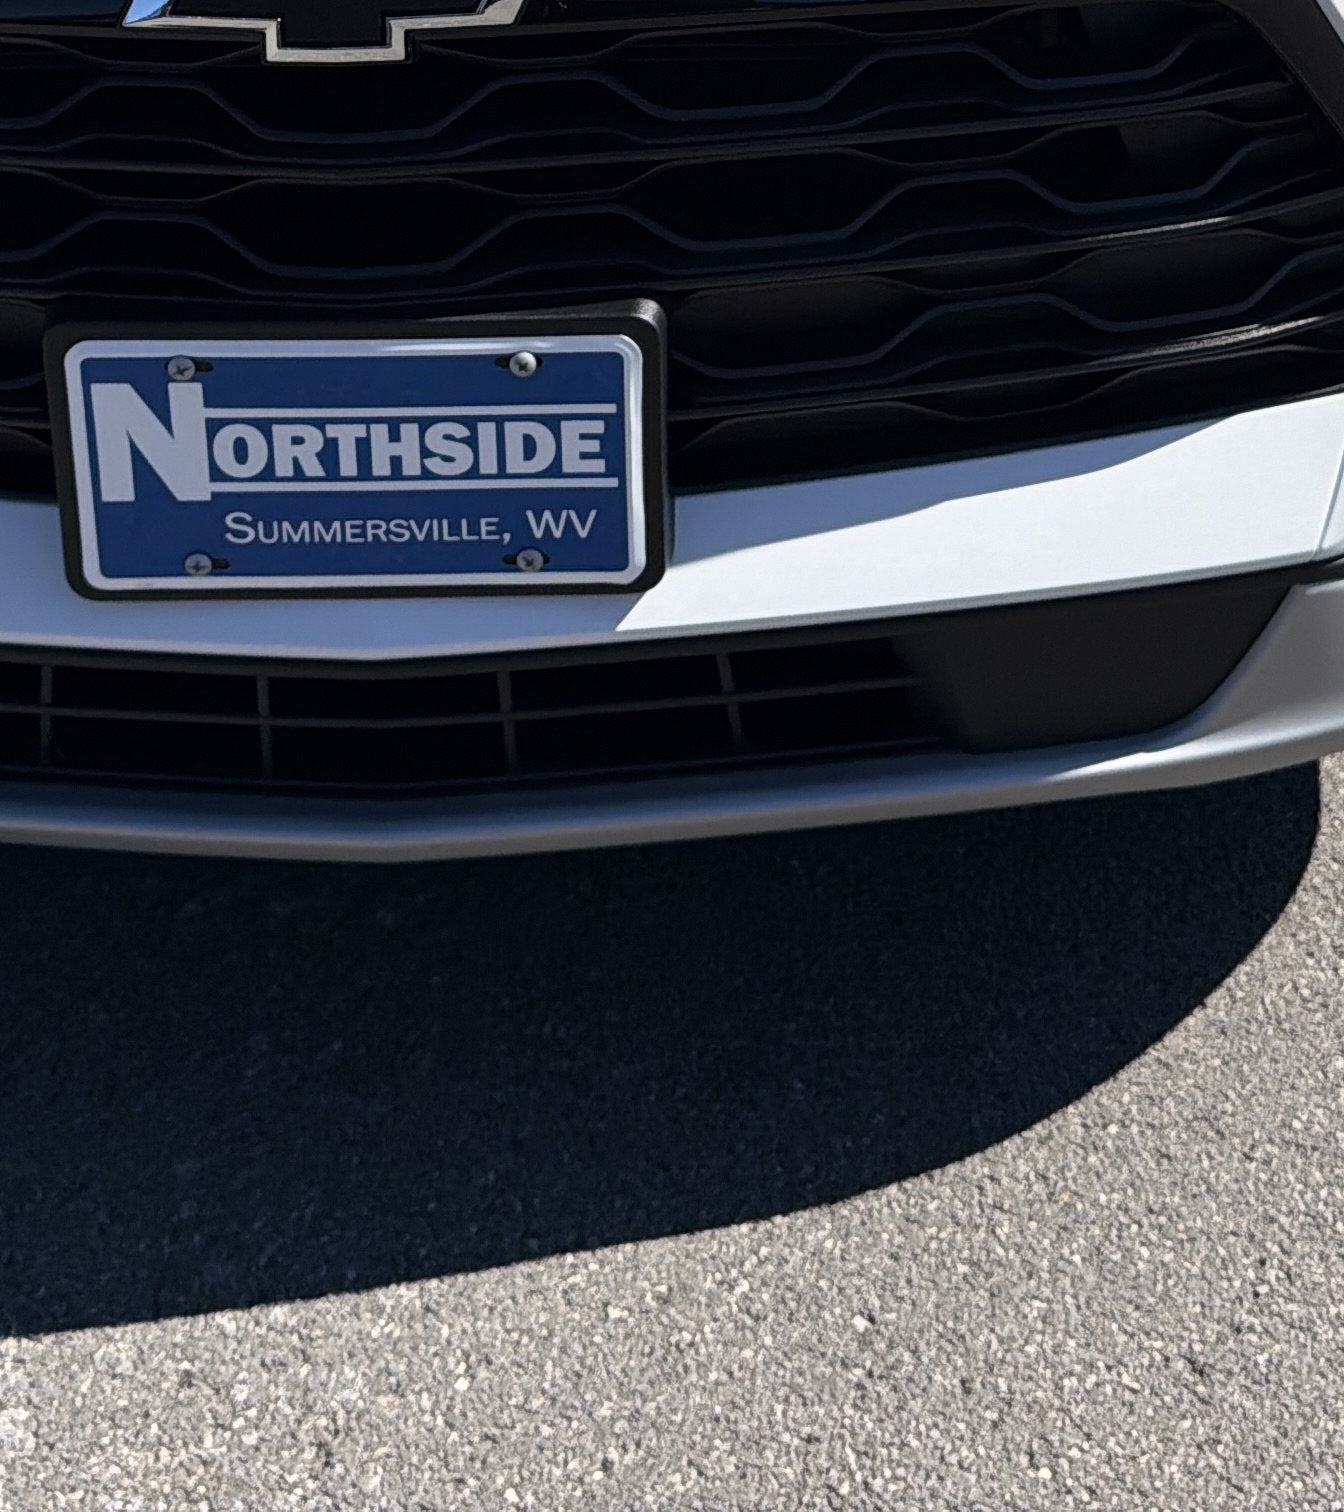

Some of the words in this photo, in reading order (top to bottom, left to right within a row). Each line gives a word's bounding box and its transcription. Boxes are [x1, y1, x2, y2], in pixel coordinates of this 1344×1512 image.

[90, 381, 607, 503] NORTHSIDE
[224, 510, 513, 547] SUMMERSVILLE,
[526, 508, 598, 540] WV
